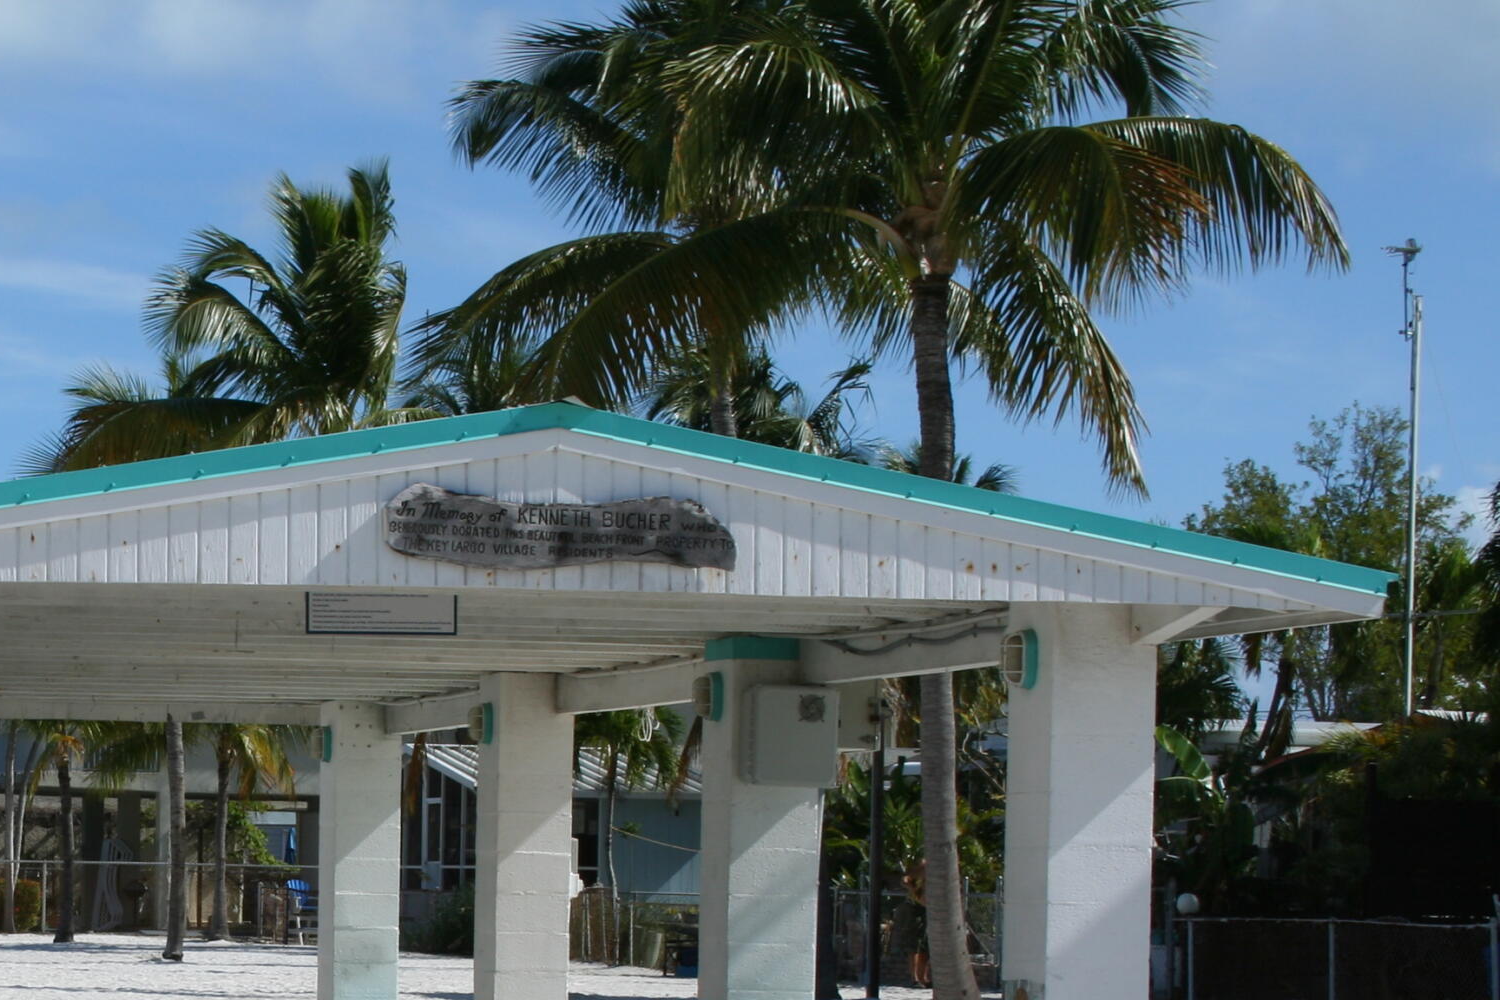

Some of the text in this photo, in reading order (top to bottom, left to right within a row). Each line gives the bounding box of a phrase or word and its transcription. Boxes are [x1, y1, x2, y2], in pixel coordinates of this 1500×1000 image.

[395, 501, 416, 517] In
[422, 501, 483, 525] Memory
[488, 508, 508, 523] of
[516, 507, 591, 528] KENNETH
[602, 511, 671, 531] BUCHER
[389, 520, 447, 535] GENEROUSLY
[452, 525, 500, 538] DONATED
[428, 540, 447, 553] KEY
[451, 541, 486, 554] LARGO
[493, 544, 536, 556] VILLAGE
